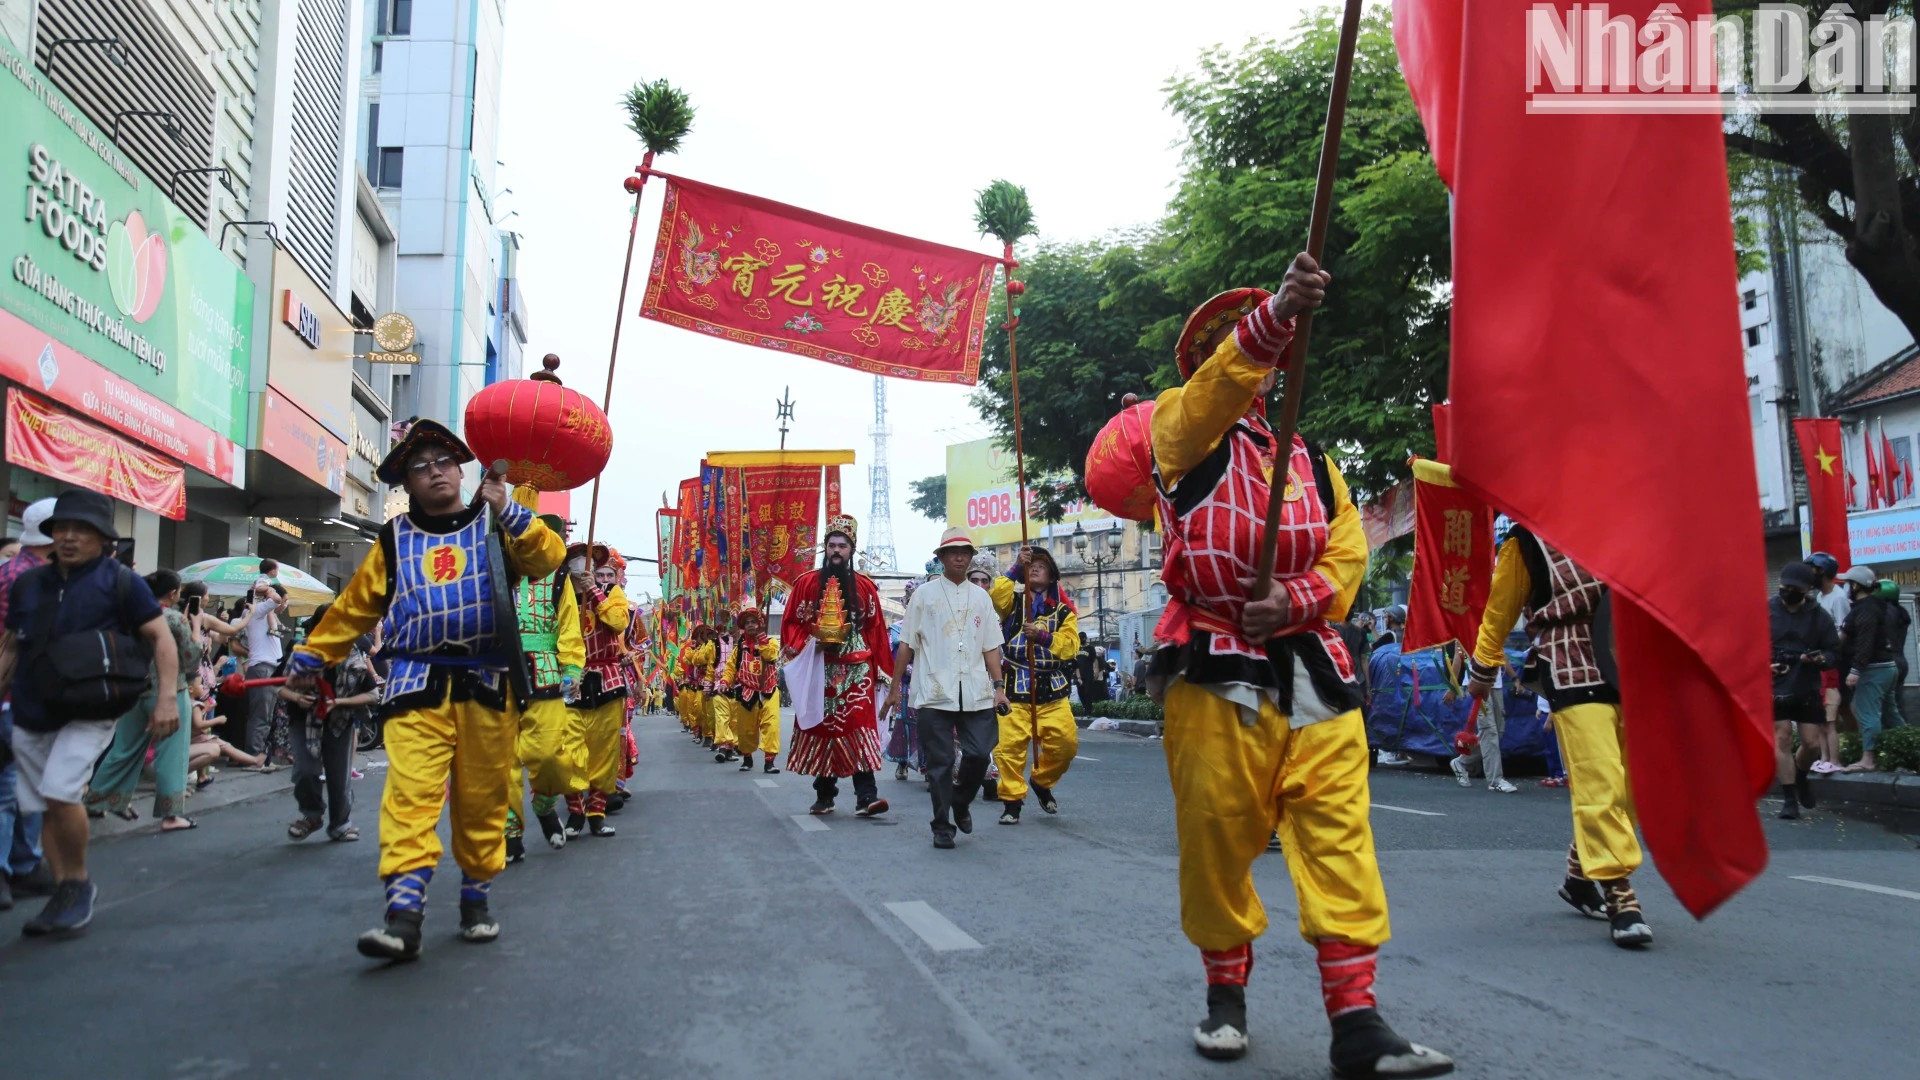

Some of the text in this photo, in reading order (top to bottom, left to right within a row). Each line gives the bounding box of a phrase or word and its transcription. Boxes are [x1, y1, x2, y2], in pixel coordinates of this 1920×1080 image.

[35, 79, 46, 101] TY
[29, 143, 107, 236] SATRA
[26, 184, 107, 272] FOODS
[14, 253, 40, 291] CỬA
[41, 273, 75, 314] HÀNG
[75, 296, 104, 333] THỰC
[104, 317, 132, 351] PHẨM
[132, 334, 151, 364] TIỆN
[152, 347, 166, 375] LỢI
[229, 324, 244, 351] gốc
[224, 359, 245, 394] ngày
[83, 391, 188, 456] CỬA HÀNG BÌNH ỔN THỊ TRƯỜNG
[104, 379, 175, 428] TỰ HÀO HÀNG VIỆT NAM
[433, 546, 457, 583] 勇
